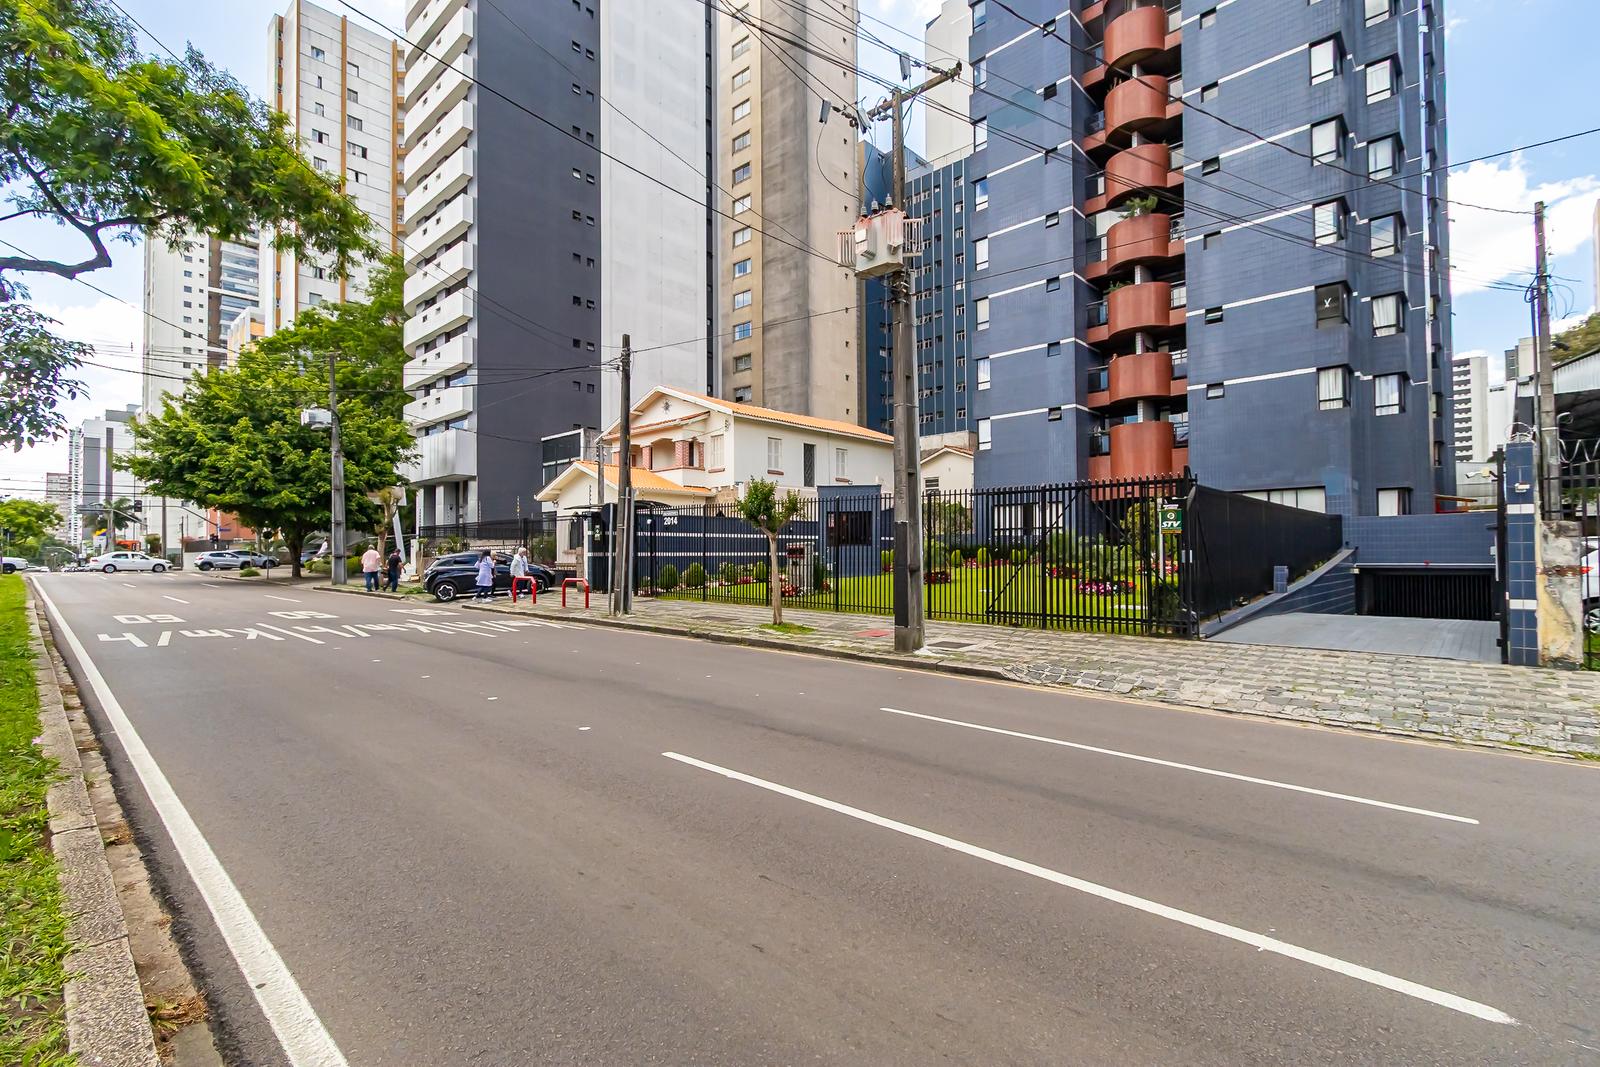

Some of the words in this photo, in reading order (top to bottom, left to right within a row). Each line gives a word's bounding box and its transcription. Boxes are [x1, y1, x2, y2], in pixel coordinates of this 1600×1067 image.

[664, 517, 678, 526] 2014
[113, 614, 187, 624] 60
[268, 611, 340, 620] 60
